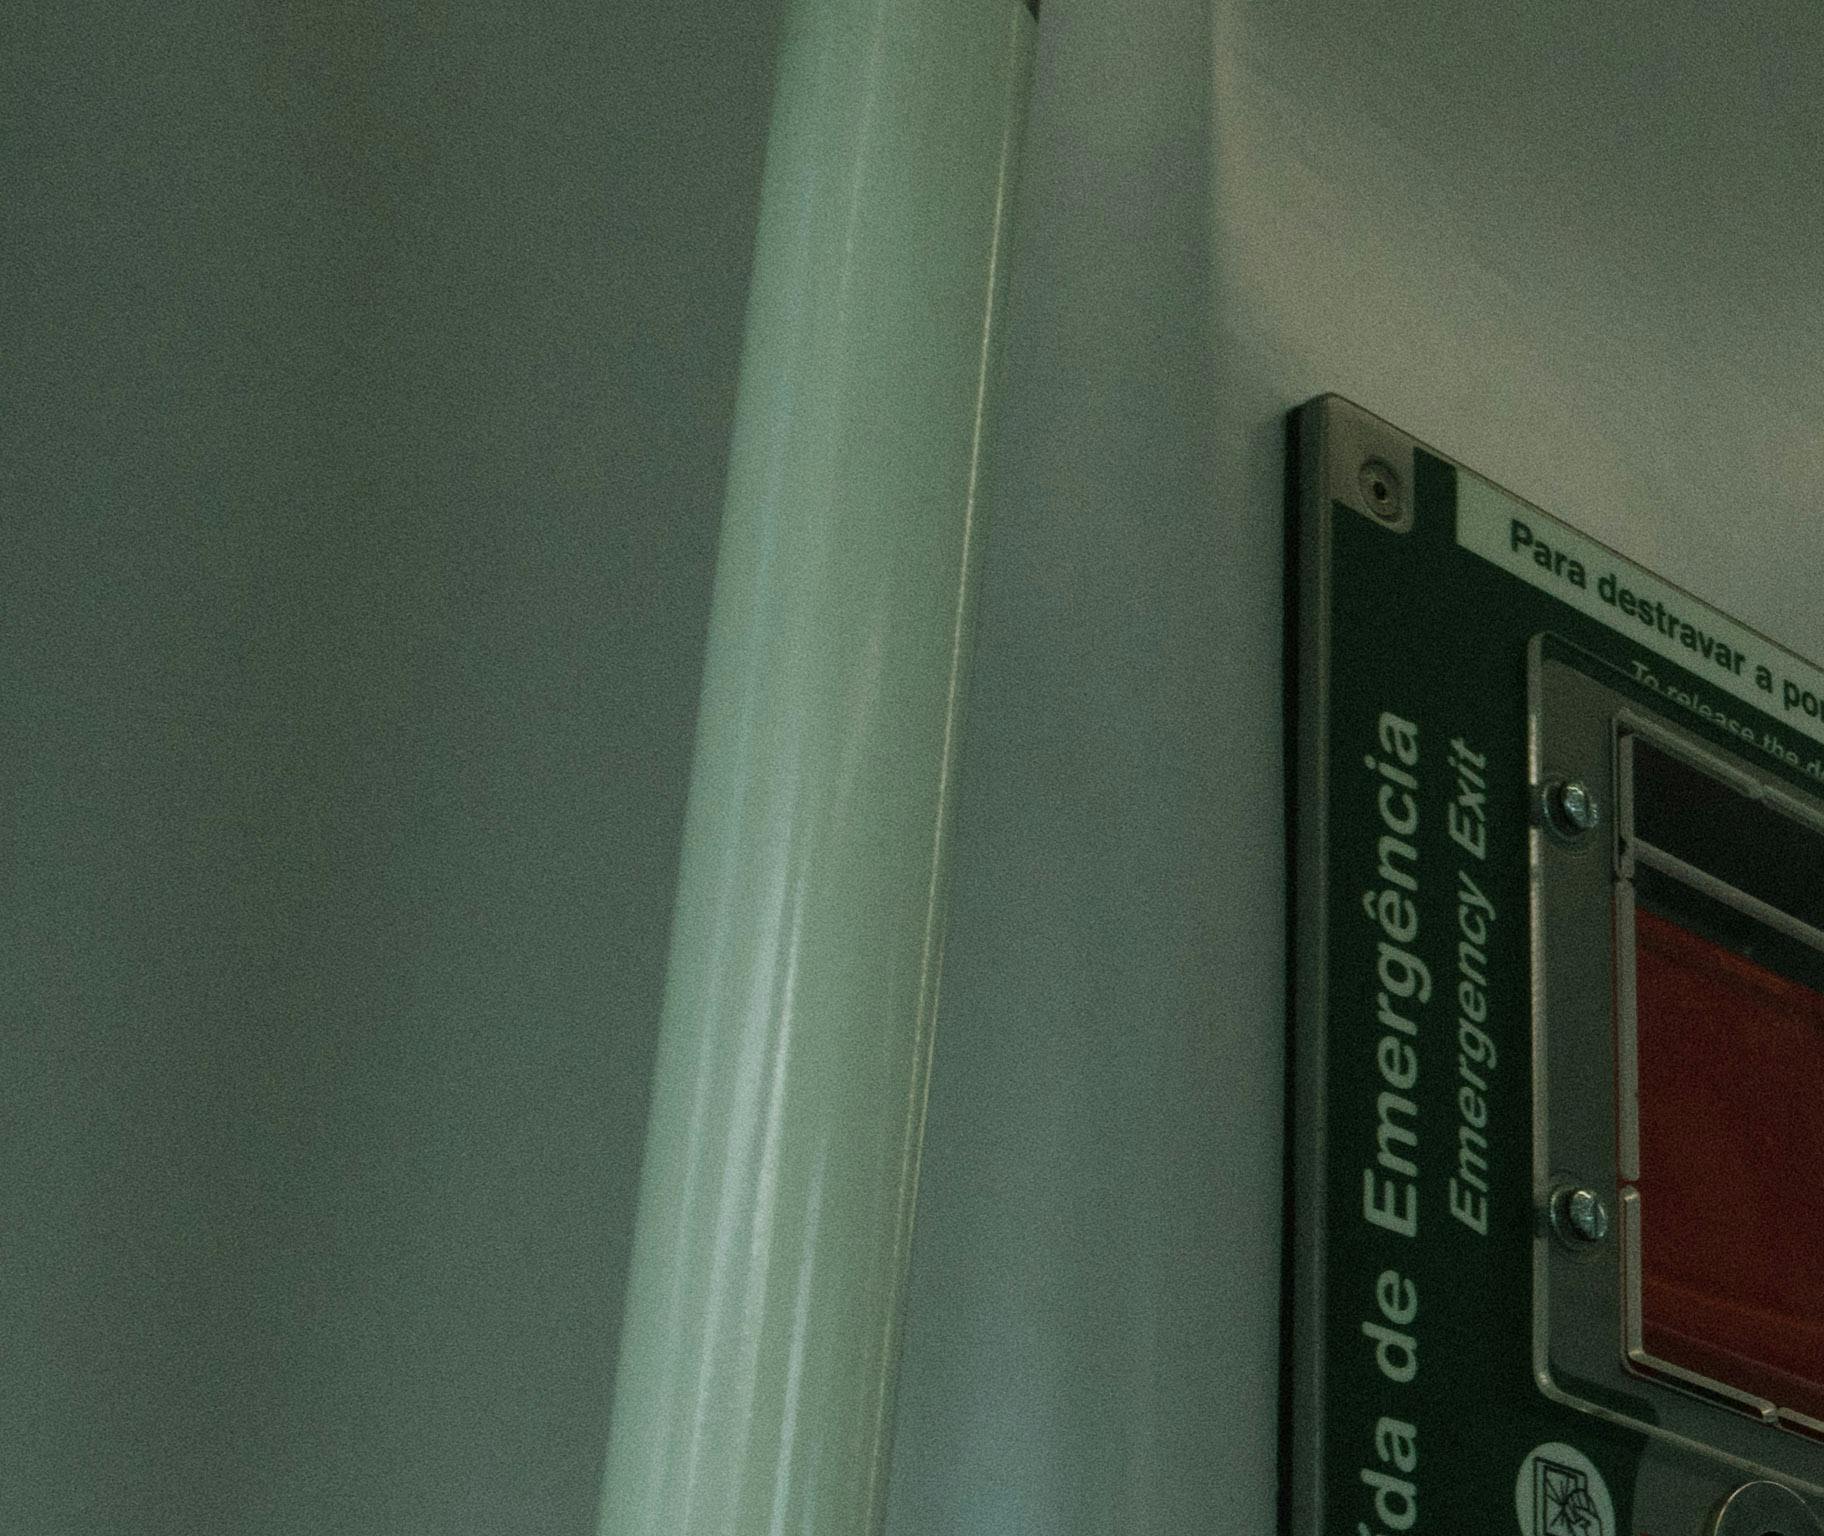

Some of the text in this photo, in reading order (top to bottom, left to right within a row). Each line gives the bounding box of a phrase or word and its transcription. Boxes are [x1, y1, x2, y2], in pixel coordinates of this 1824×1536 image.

[1509, 518, 1586, 590] Para
[1598, 574, 1745, 676] destravar
[1756, 664, 1775, 694] a
[1632, 659, 1659, 690] To
[1667, 685, 1755, 742] release
[1763, 732, 1800, 766] the
[1362, 711, 1432, 1239] Emergência
[1449, 736, 1497, 1236] Emergency Exit
[1361, 1268, 1418, 1384] de
